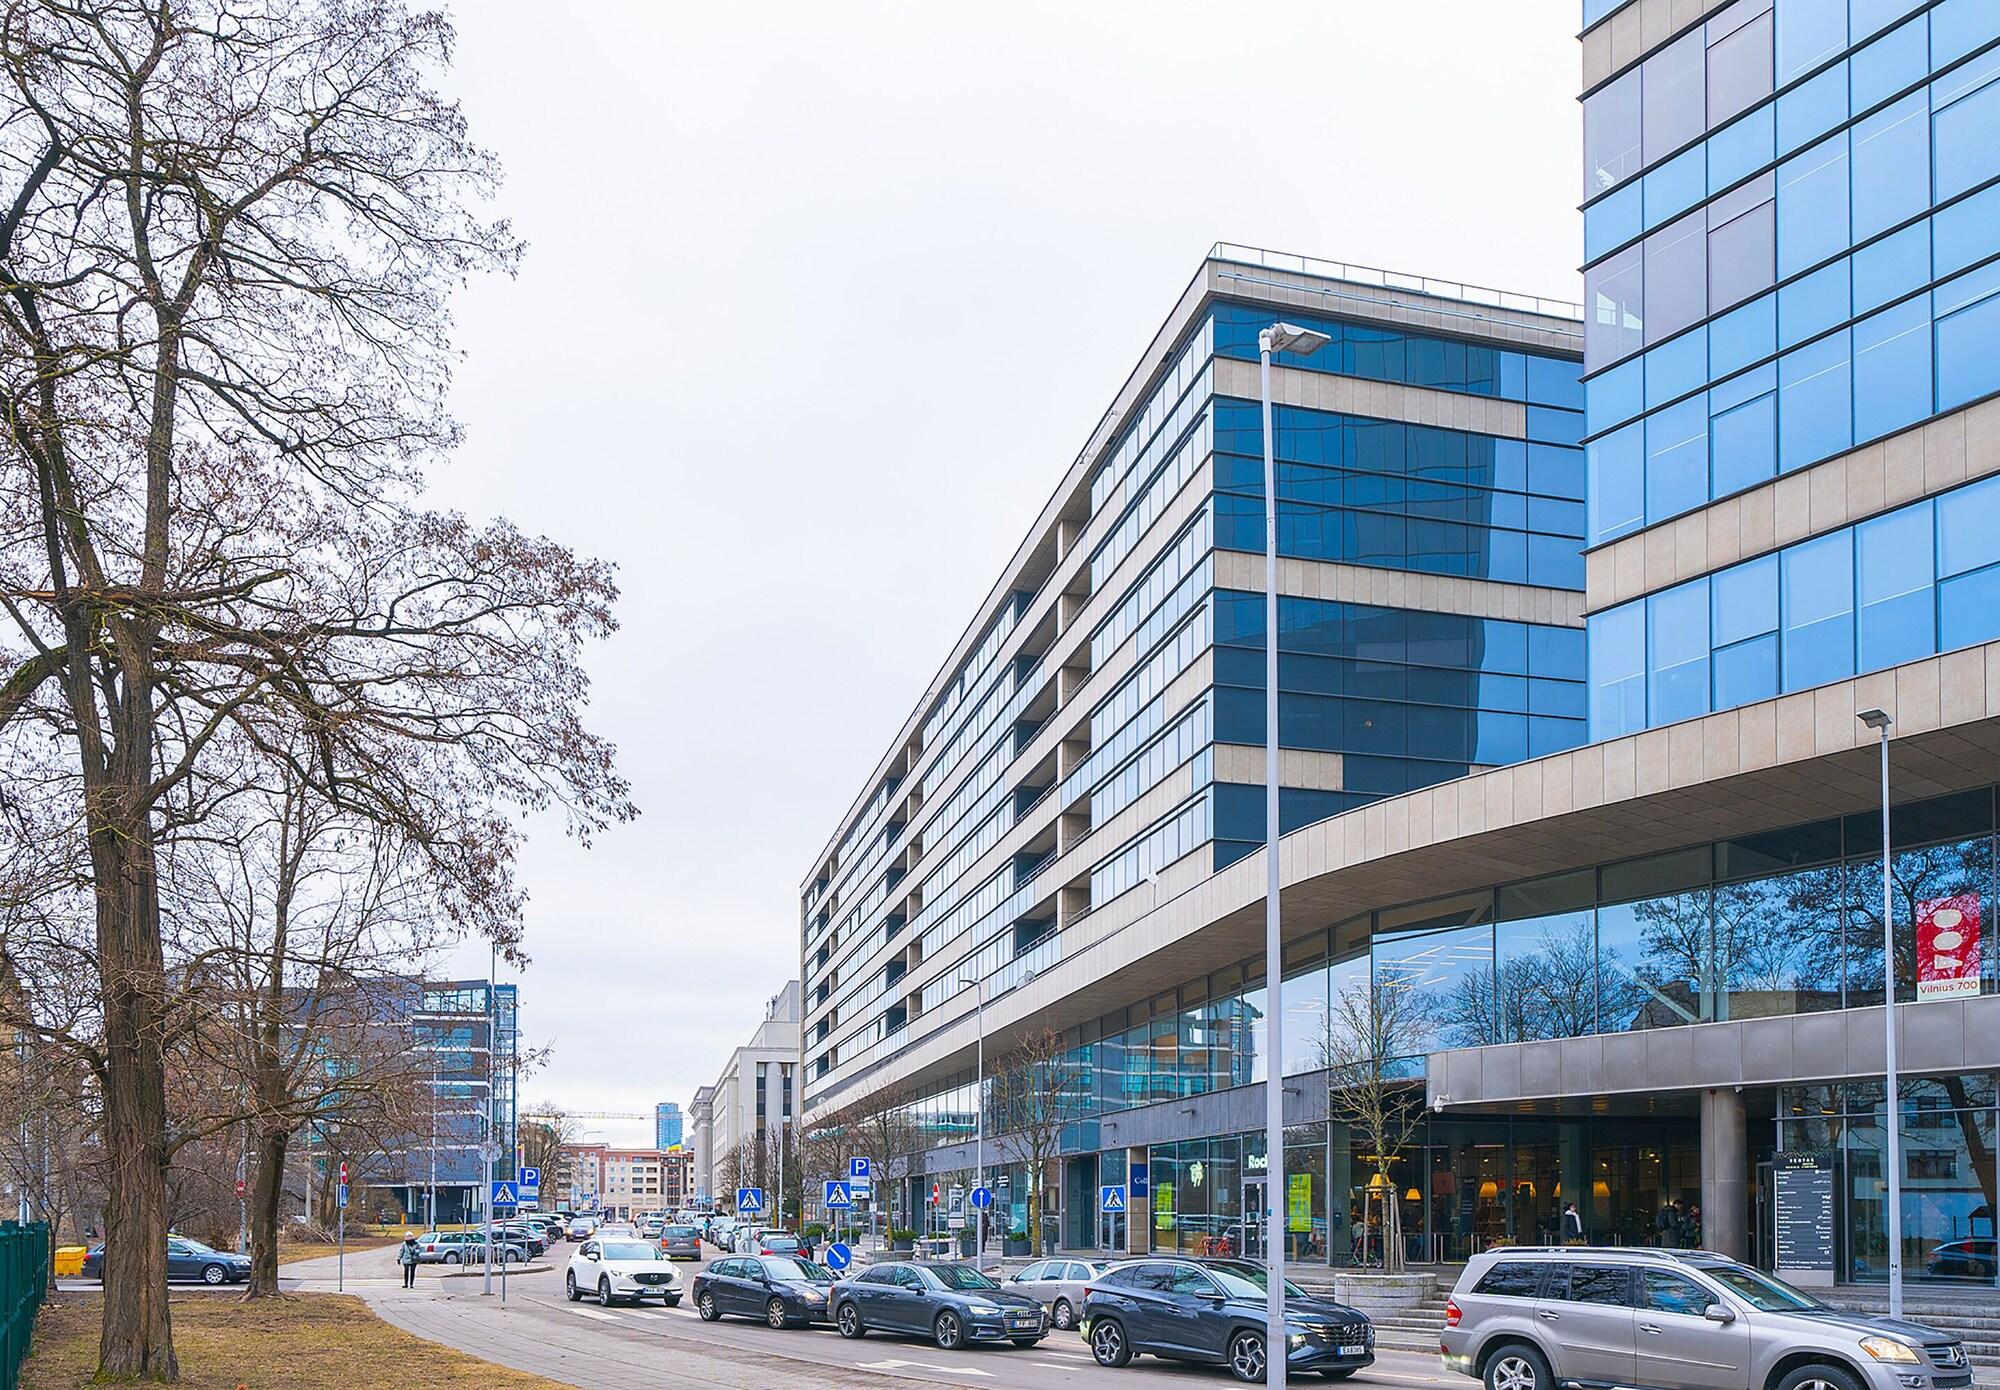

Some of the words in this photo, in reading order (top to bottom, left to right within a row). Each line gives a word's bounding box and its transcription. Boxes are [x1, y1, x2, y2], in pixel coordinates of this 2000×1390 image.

[1920, 984, 1954, 993] Vilnius
[1957, 981, 1978, 990] 700
[855, 1159, 867, 1175] P
[525, 1169, 536, 1185] P
